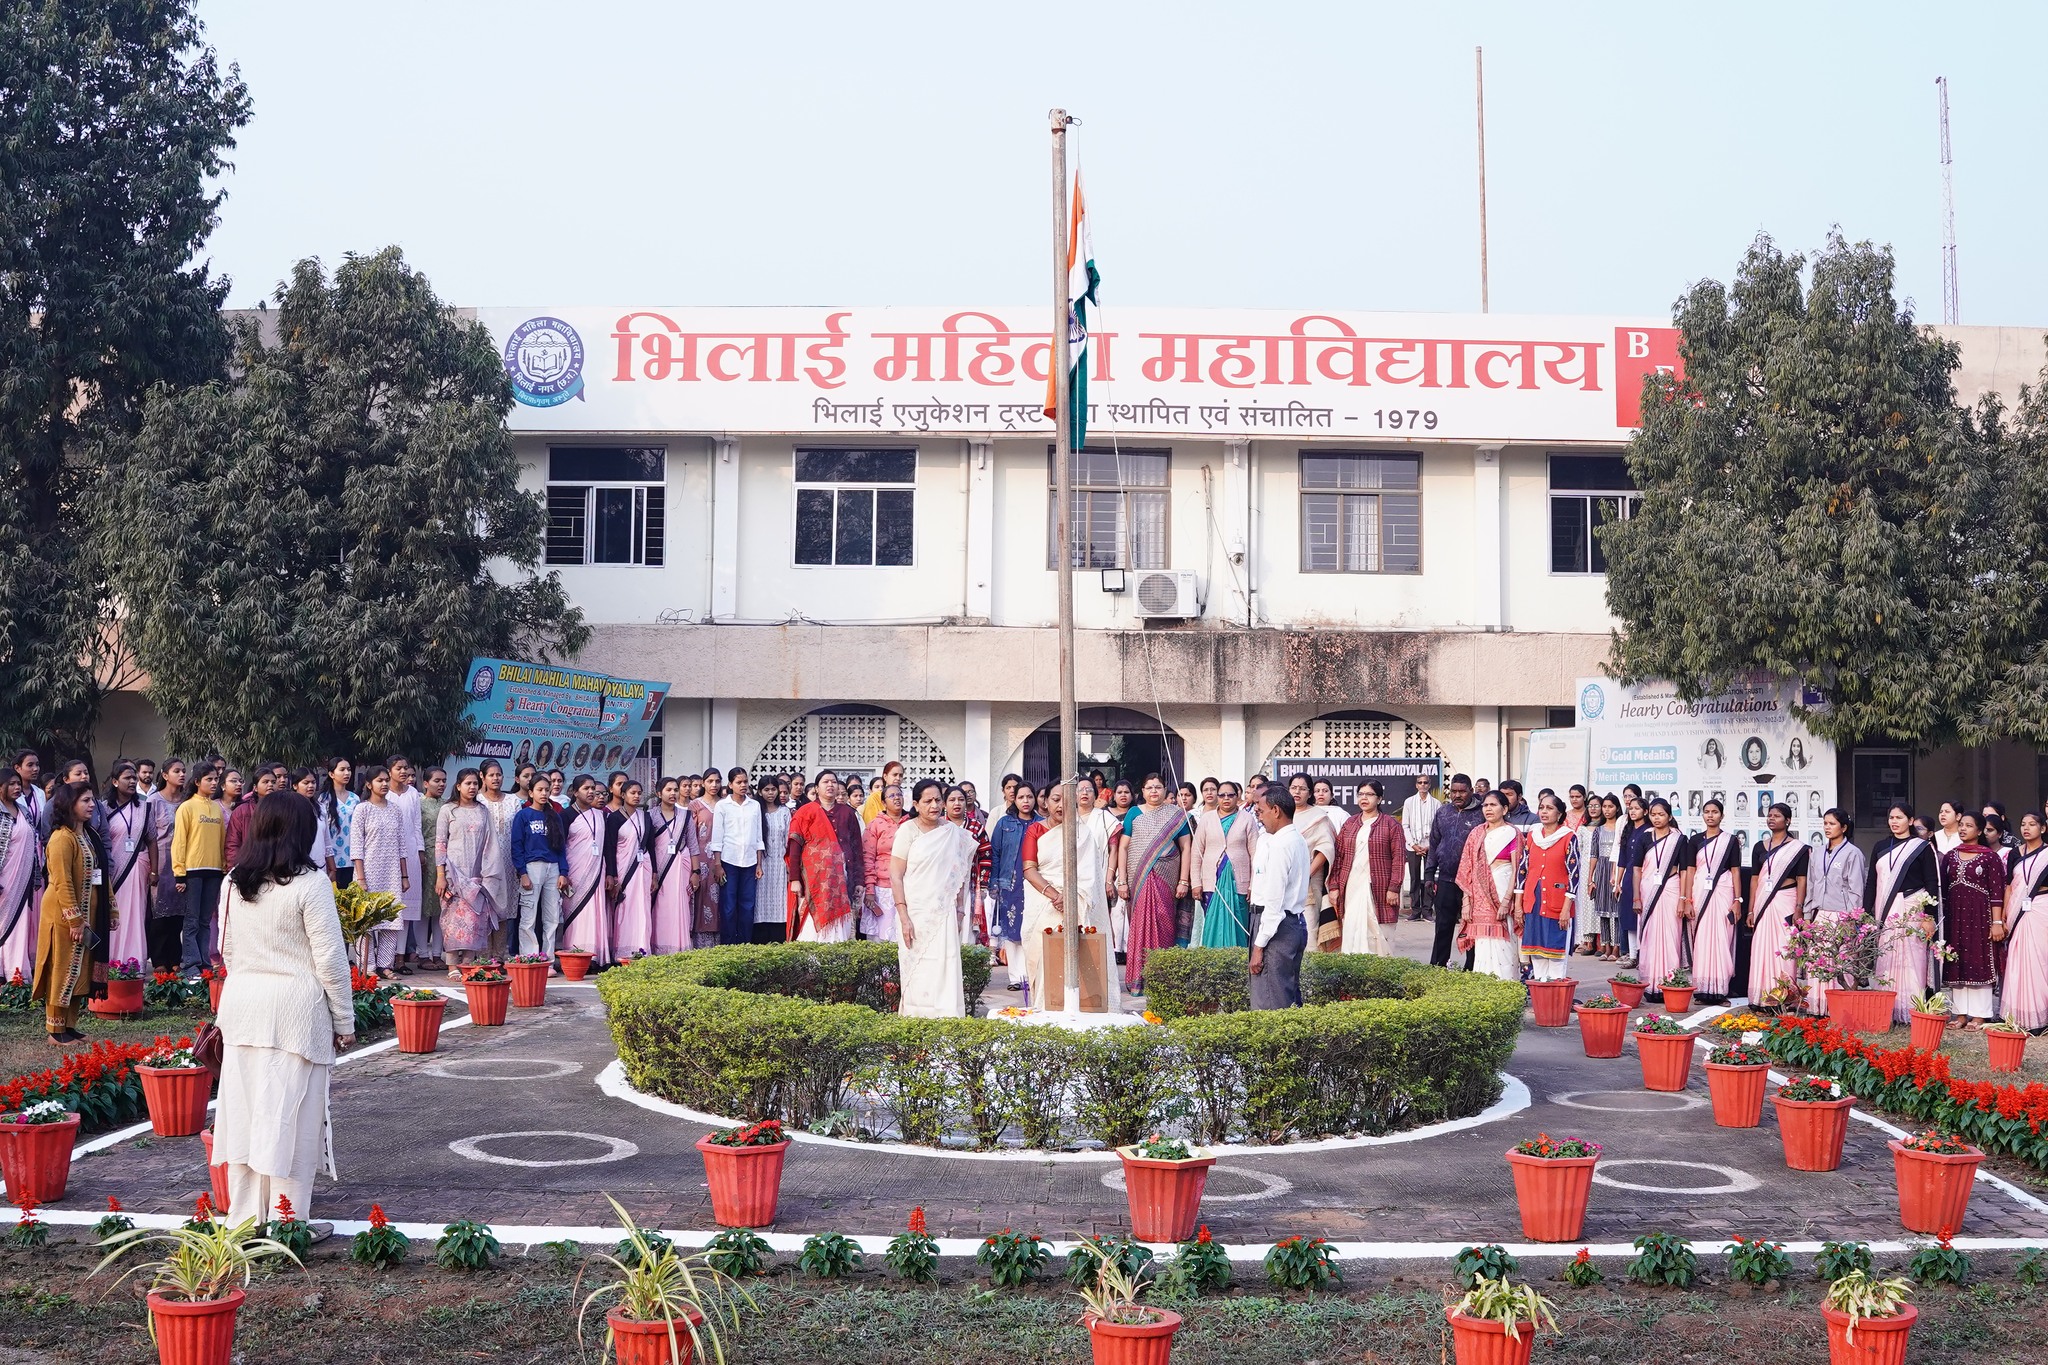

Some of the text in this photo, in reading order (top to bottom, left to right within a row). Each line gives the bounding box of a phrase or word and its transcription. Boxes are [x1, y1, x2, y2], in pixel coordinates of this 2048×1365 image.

[506, 320, 581, 362] भिलाई महिला महाविद्यालय
[611, 312, 852, 390] भिलाई
[1139, 315, 1605, 392] महाविद्यालय
[513, 371, 536, 393] भिलाई
[538, 385, 555, 394] नगर
[812, 396, 884, 424] भिलाई
[892, 396, 988, 431] एजुकेशन
[998, 404, 1044, 430] ट्रस्ट
[1107, 397, 1190, 427] स्थापित
[1200, 398, 1228, 430] एवं
[1238, 398, 1333, 429] संचालित
[1373, 409, 1439, 431] 1979
[498, 663, 533, 684] BHILAI
[532, 669, 570, 689] MAHILA
[571, 673, 645, 700] MAHAVDYALAYA
[518, 696, 549, 714] Hearty
[1620, 702, 1663, 719] Hearty
[1667, 698, 1778, 717] Congratulations
[492, 723, 529, 735] HEMCHAND
[530, 727, 550, 736] YADAV
[465, 741, 512, 757] Gold Medalist
[1600, 747, 1675, 761] 3 Gold Medalist
[1318, 764, 1362, 777] MAHILA
[1362, 764, 1438, 776] MAHAVIDYALAYA
[1599, 772, 1618, 782] Merit
[1620, 771, 1640, 781] Rank
[1641, 771, 1674, 781] Holders
